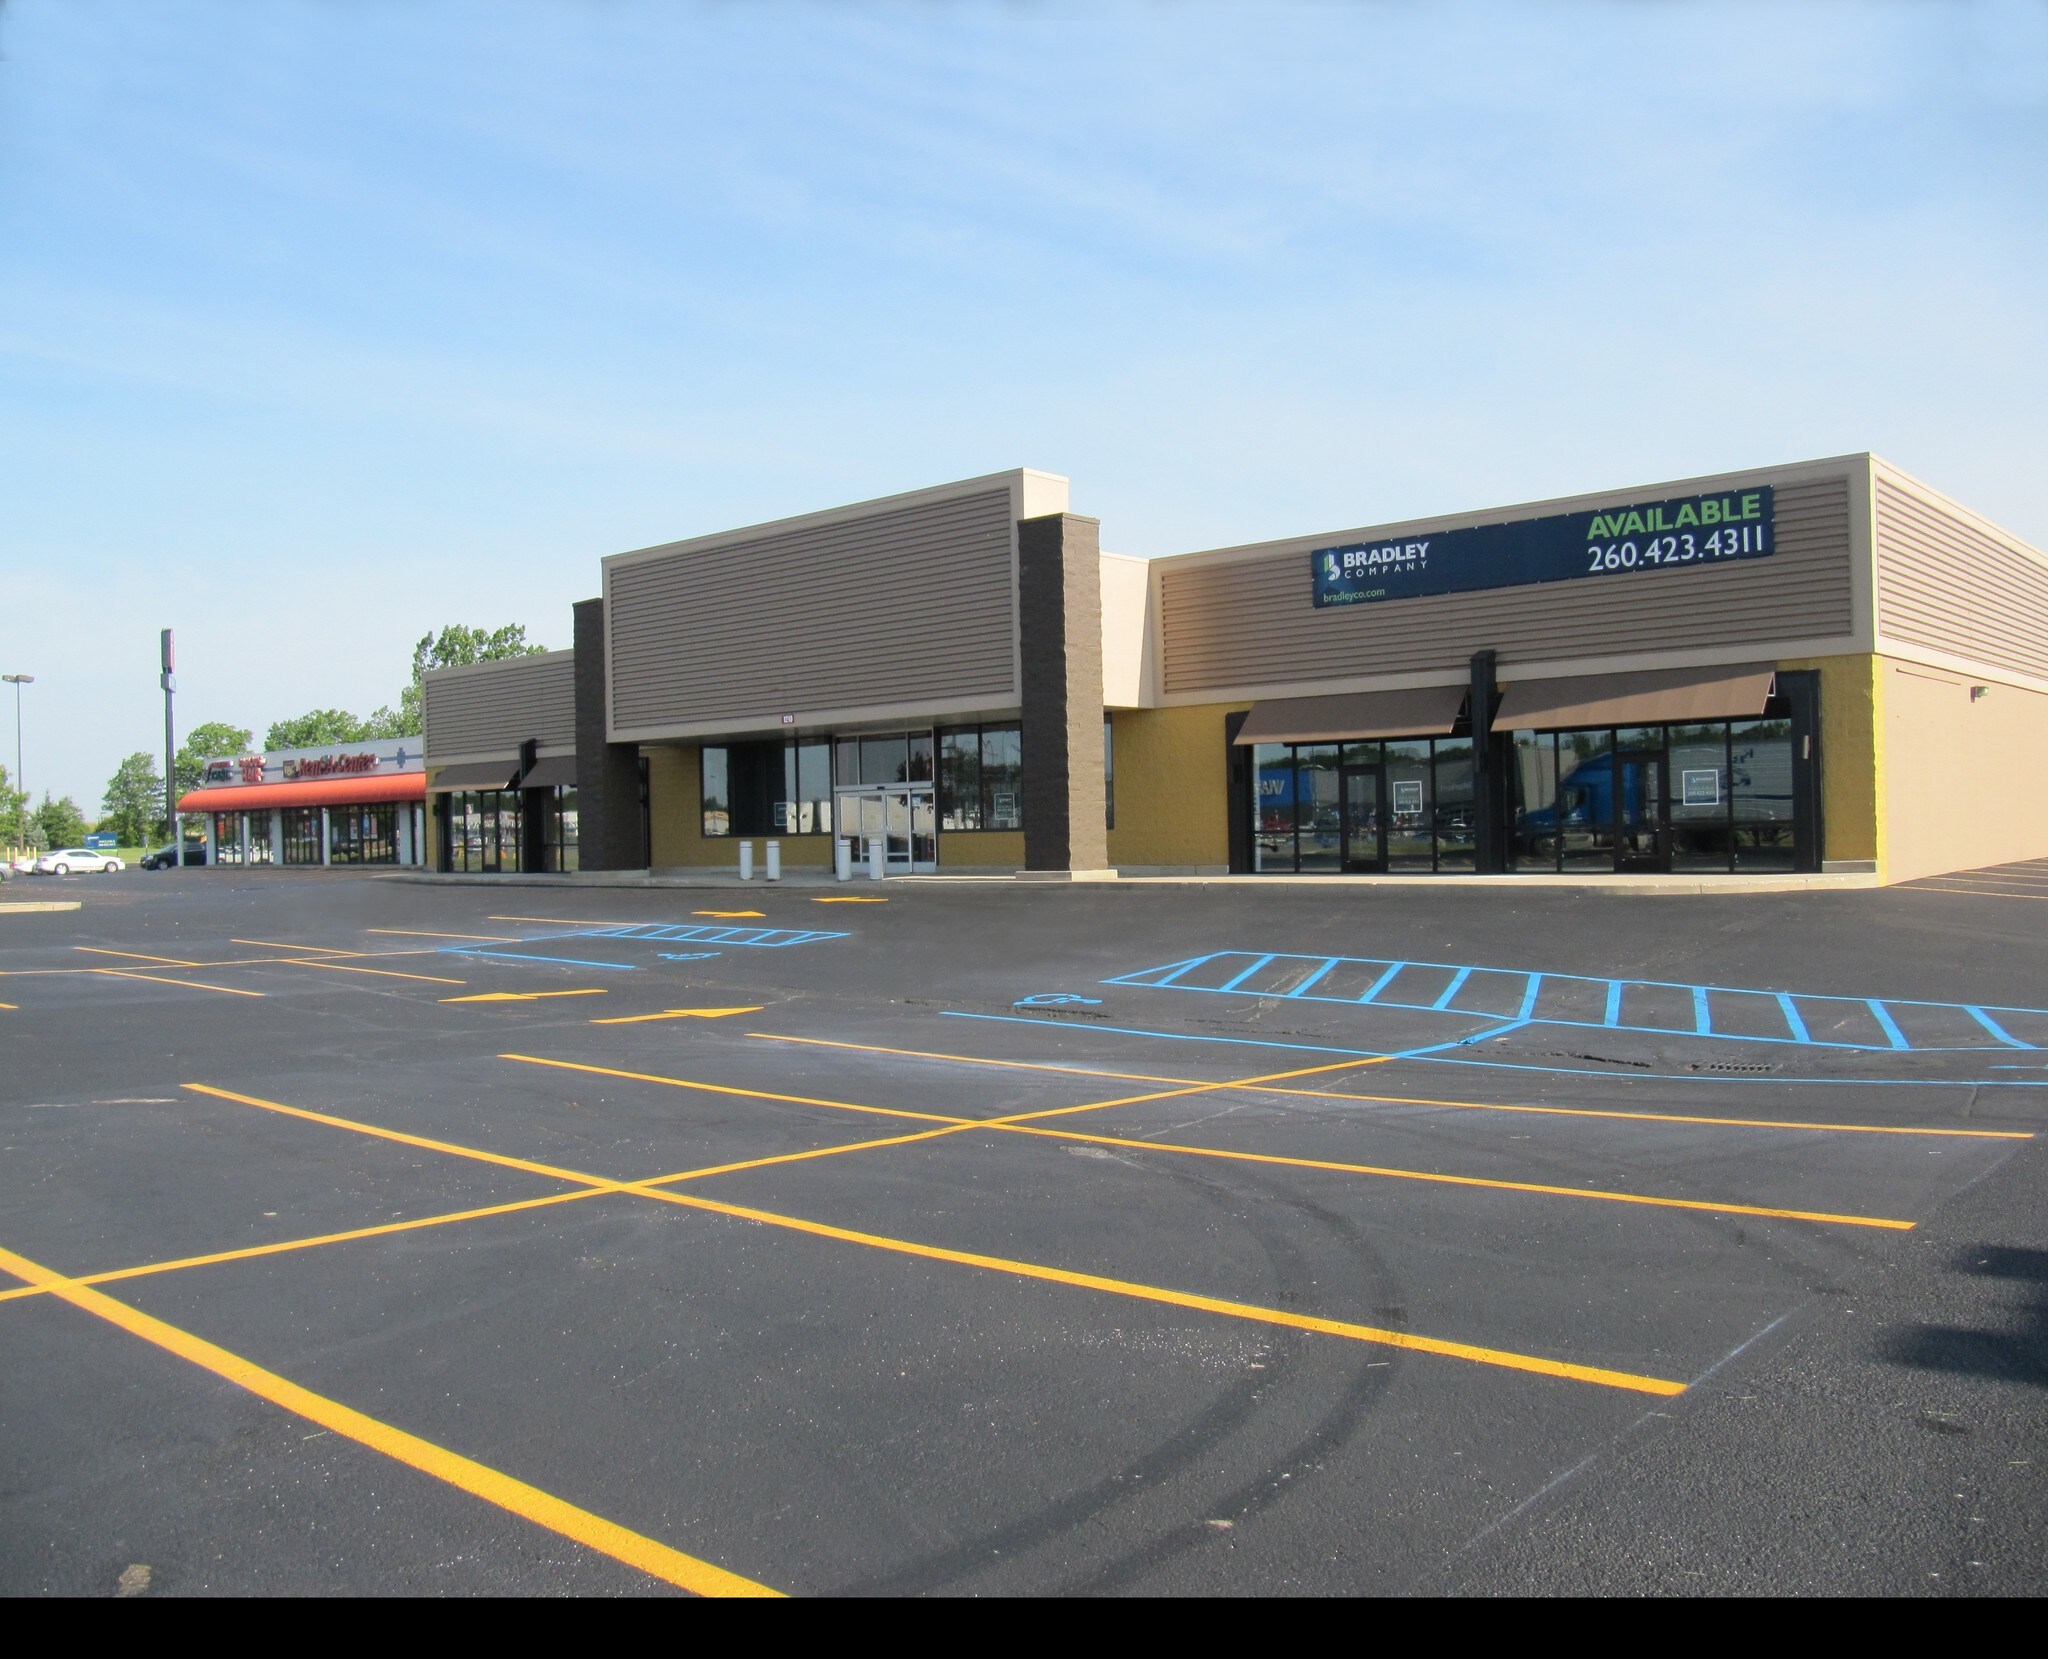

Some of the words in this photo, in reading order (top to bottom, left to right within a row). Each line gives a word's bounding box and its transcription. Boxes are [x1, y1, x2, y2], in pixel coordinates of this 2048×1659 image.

[1587, 494, 1761, 540] AVAILABLE
[1343, 542, 1430, 568] BRADLEY
[1588, 526, 1763, 572] 260.423.4311
[1344, 561, 1427, 579] COMPANY
[1323, 588, 1386, 603] bradleyco.com
